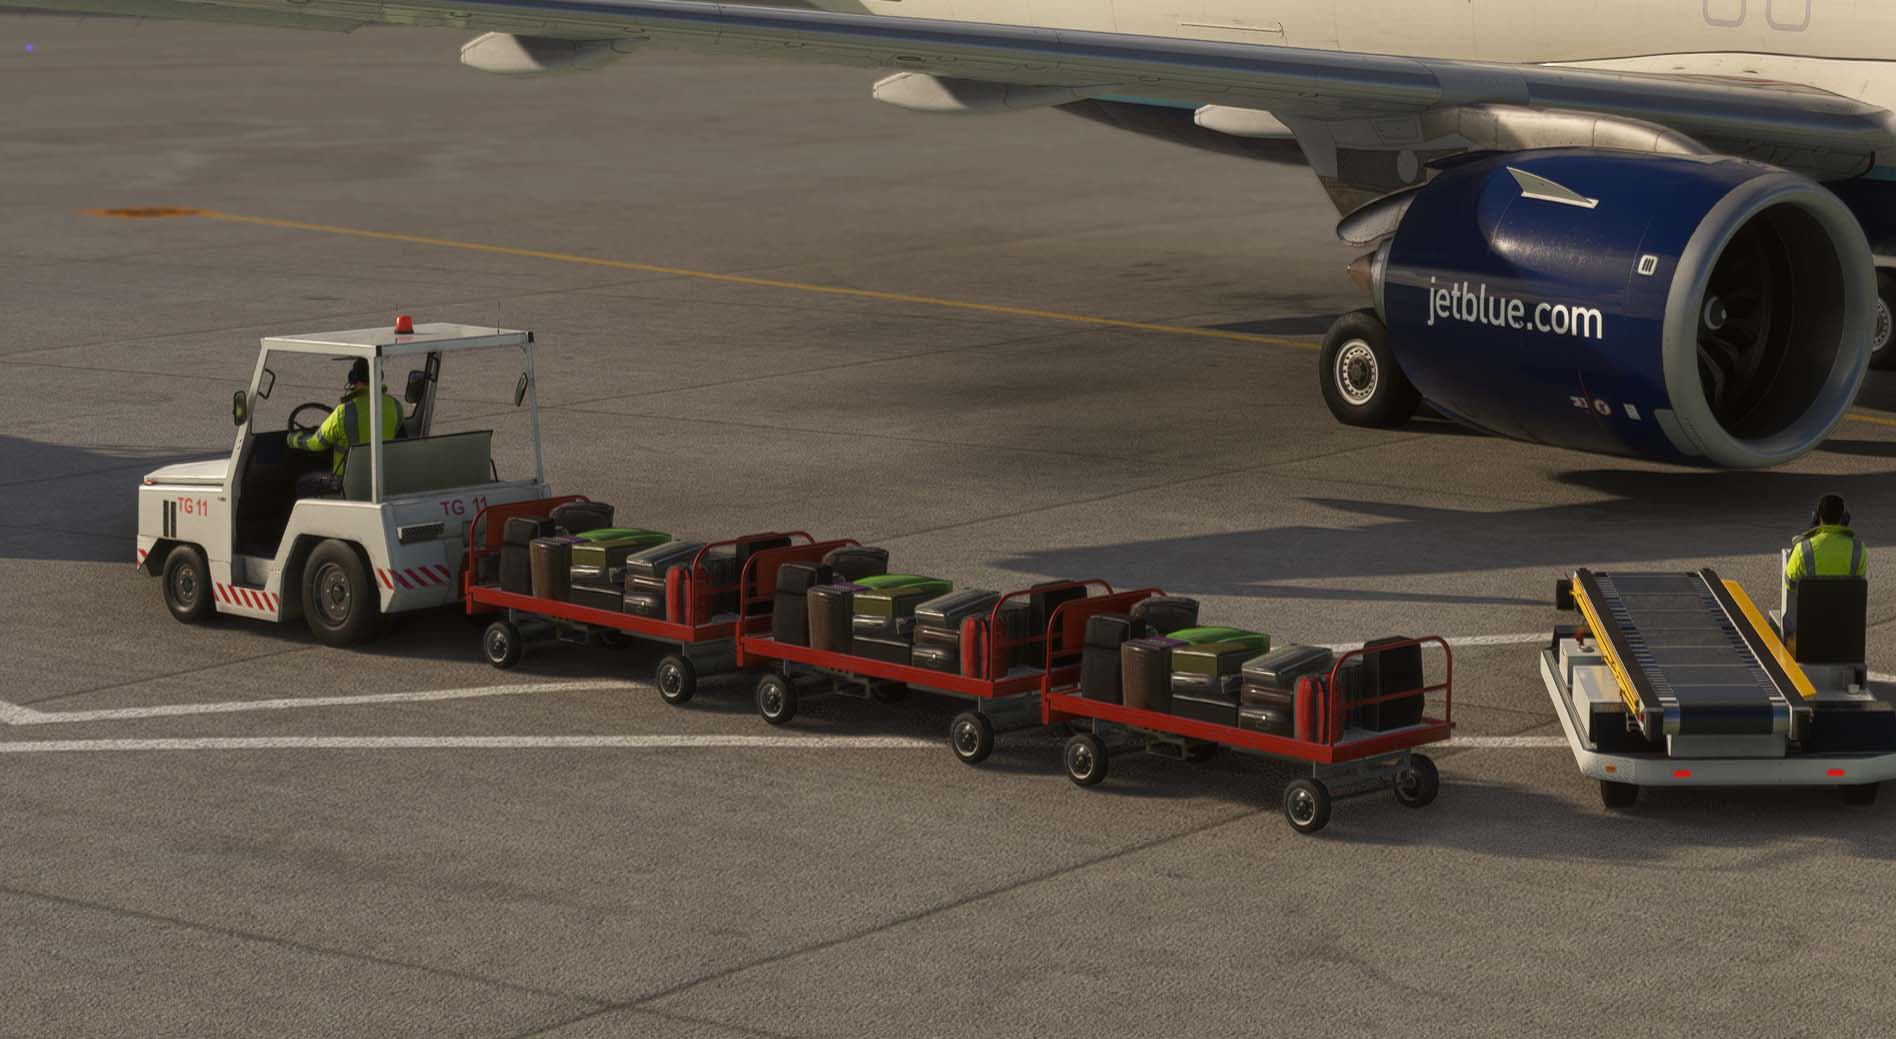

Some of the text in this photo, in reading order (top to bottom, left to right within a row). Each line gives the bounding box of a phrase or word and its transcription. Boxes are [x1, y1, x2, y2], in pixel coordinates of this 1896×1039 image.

[1427, 275, 1603, 340] jetblue.com
[177, 495, 208, 517] TG 11
[439, 499, 465, 516] TG
